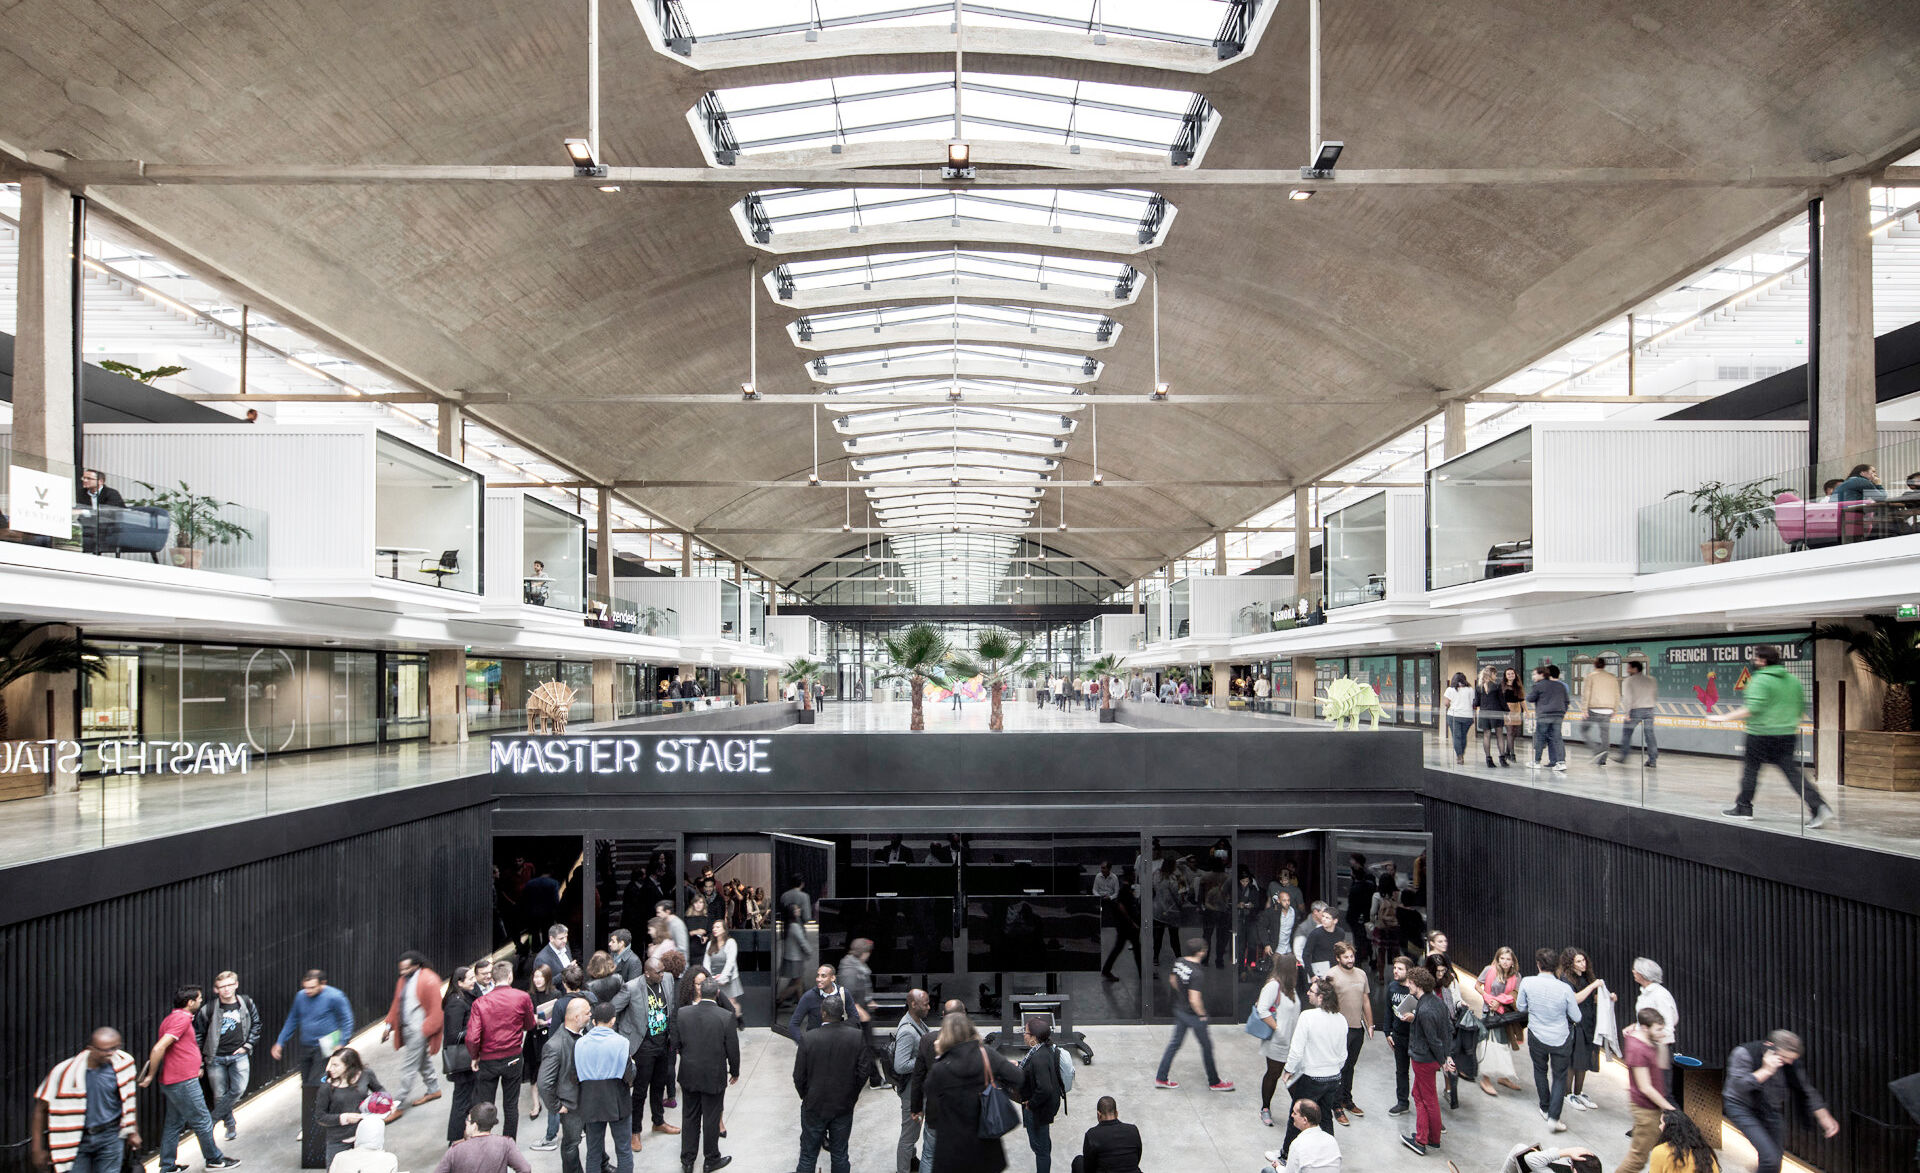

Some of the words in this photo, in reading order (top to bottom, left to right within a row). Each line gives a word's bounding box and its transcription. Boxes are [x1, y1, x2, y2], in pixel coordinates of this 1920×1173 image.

[1273, 608, 1295, 622] ASHOKA
[1669, 648, 1707, 662] FRENCH
[1712, 646, 1739, 661] TECH
[1744, 644, 1798, 660] CERAL
[491, 739, 641, 774] MASTER
[656, 739, 772, 774] STAGE
